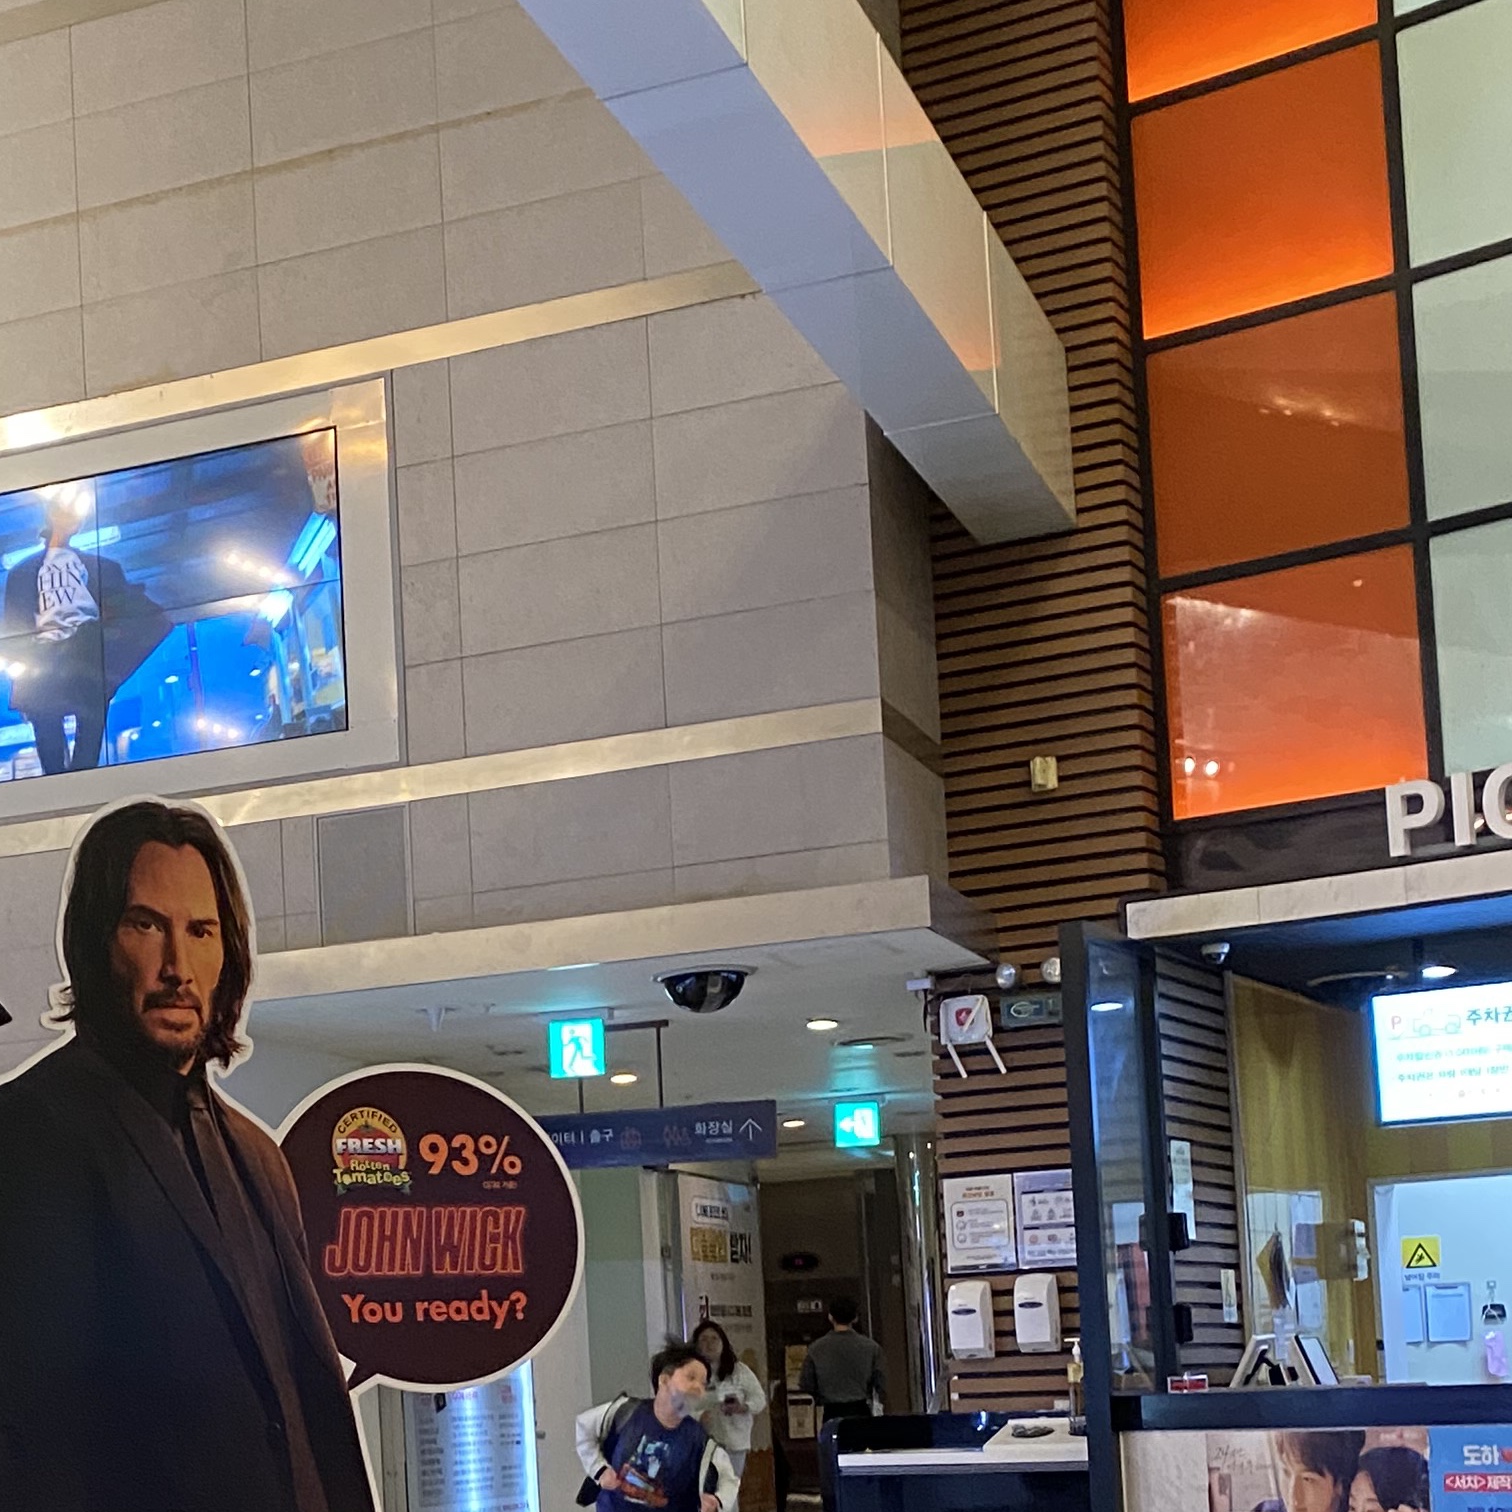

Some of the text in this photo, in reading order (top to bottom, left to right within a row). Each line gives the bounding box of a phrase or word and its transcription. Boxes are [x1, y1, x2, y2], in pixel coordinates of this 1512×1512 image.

[337, 1109, 398, 1134] CERTIFIED
[694, 1119, 733, 1136] 화장실
[335, 1137, 402, 1154] FRESH
[547, 1129, 575, 1146] 이터
[349, 1158, 391, 1171] Rotten
[418, 1133, 523, 1177] 93%
[332, 1168, 410, 1186] Tomatoes
[322, 1205, 526, 1277] JOHN WICK
[341, 1289, 527, 1329] You ready?
[1463, 1444, 1499, 1466] 도하
